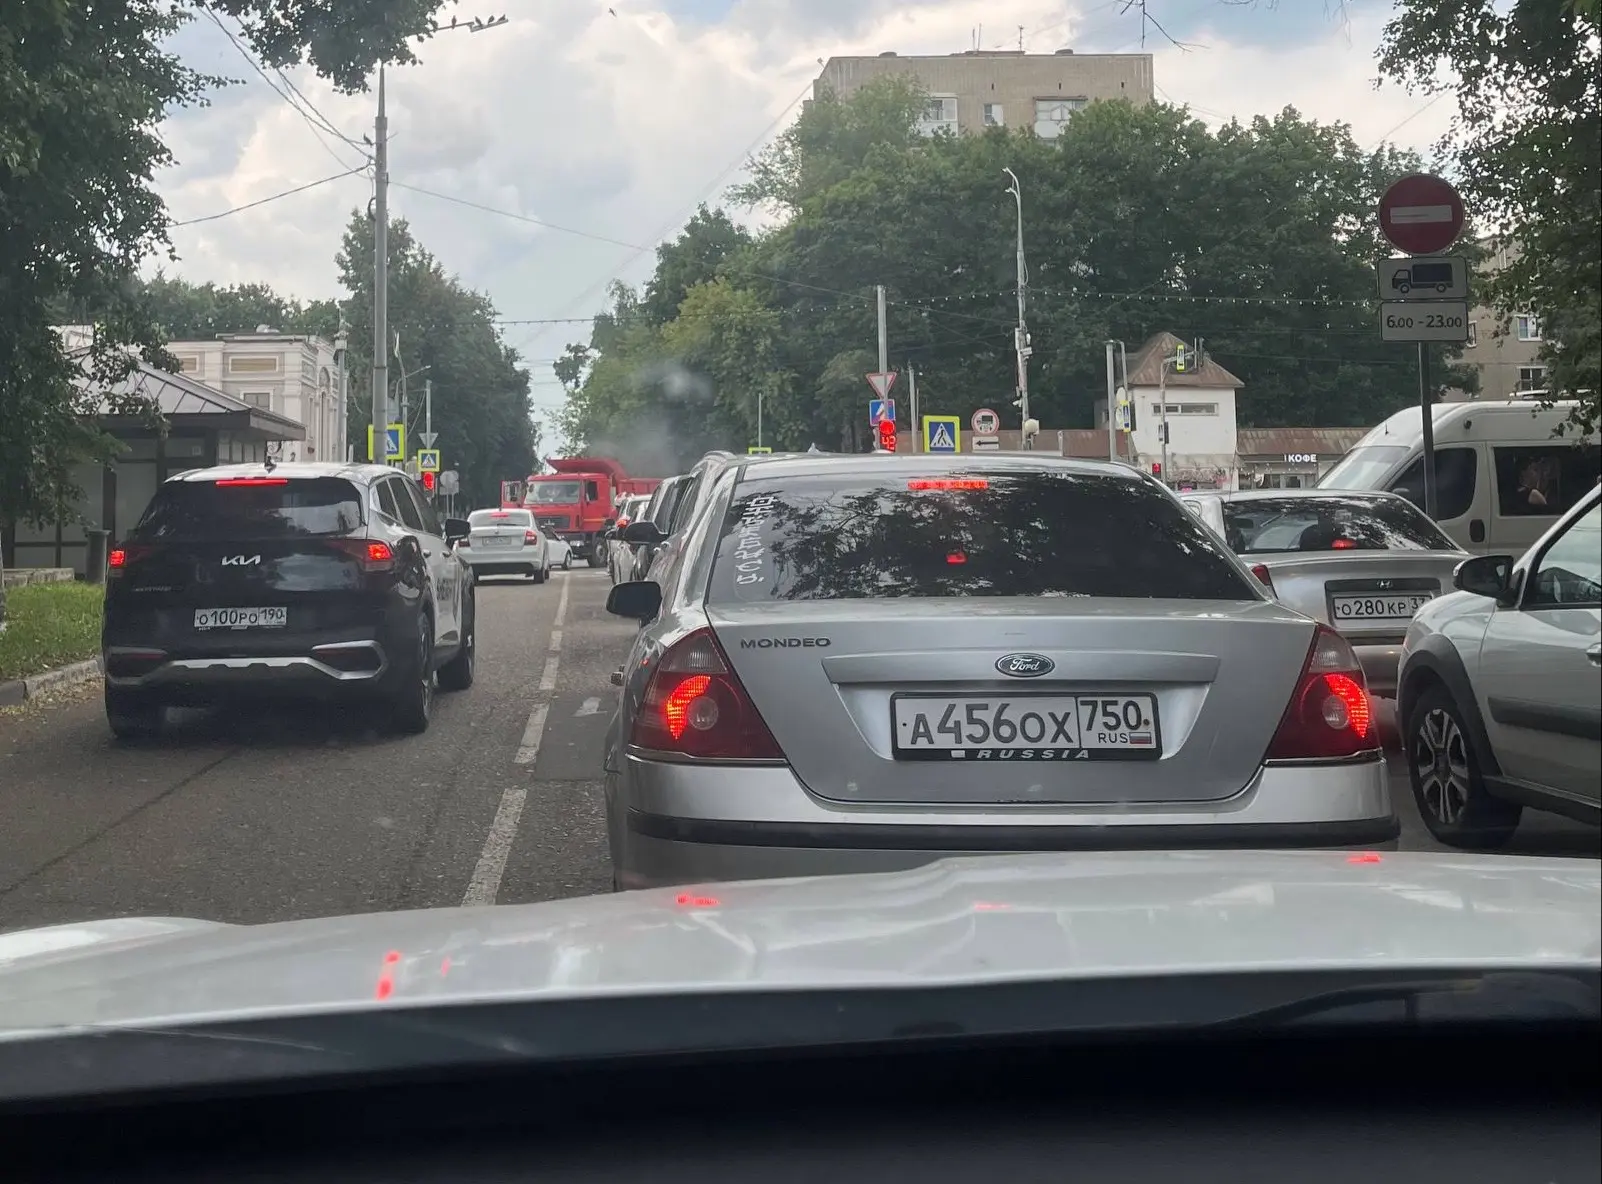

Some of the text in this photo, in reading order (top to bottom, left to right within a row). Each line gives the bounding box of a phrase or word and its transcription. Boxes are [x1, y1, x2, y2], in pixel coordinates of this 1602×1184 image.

[1386, 314, 1414, 329] 6.00
[1426, 314, 1463, 329] 23.00
[1288, 453, 1317, 463] КОФЕ
[259, 608, 283, 620] 190
[740, 637, 831, 649] MONDEO
[1009, 657, 1041, 672] Ford
[910, 699, 1143, 745] А456ОХ 750
[1097, 732, 1129, 745] RUS
[976, 749, 1090, 760] RUSSIA
